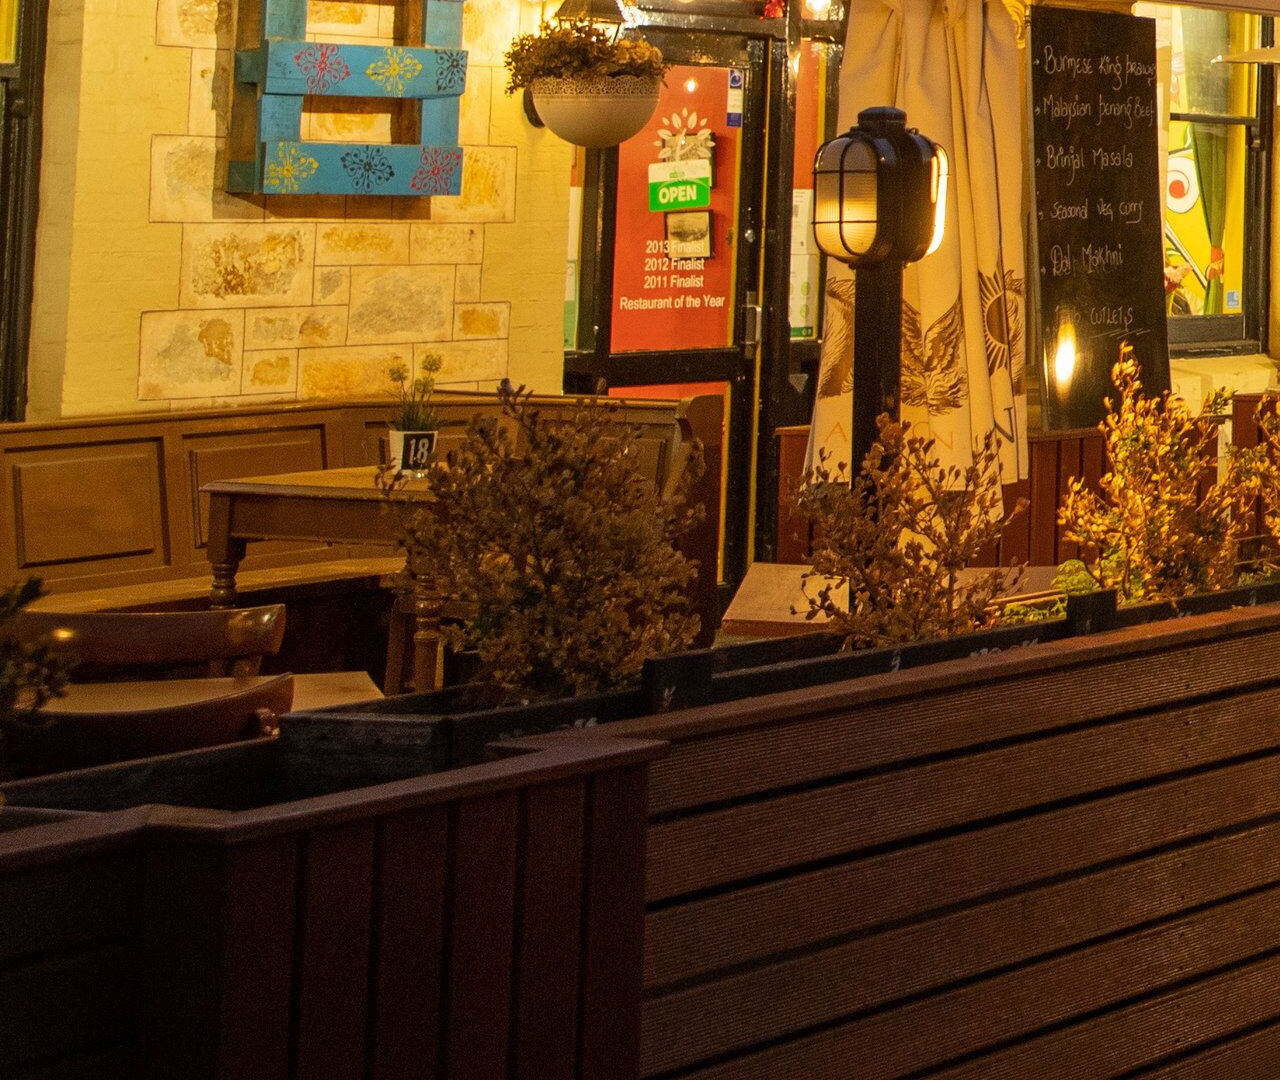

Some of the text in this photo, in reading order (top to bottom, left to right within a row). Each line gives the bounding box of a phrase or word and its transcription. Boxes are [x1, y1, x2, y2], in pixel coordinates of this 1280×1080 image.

[1046, 144, 1133, 186] Brinjal Masala
[658, 184, 697, 204] OPEN
[646, 240, 705, 254] 2013 Finalist
[644, 257, 705, 271] 2012 Finalist
[643, 274, 704, 289] 2011 Finalist
[619, 294, 725, 310] Restaurant of the Year
[409, 438, 429, 465] 18
